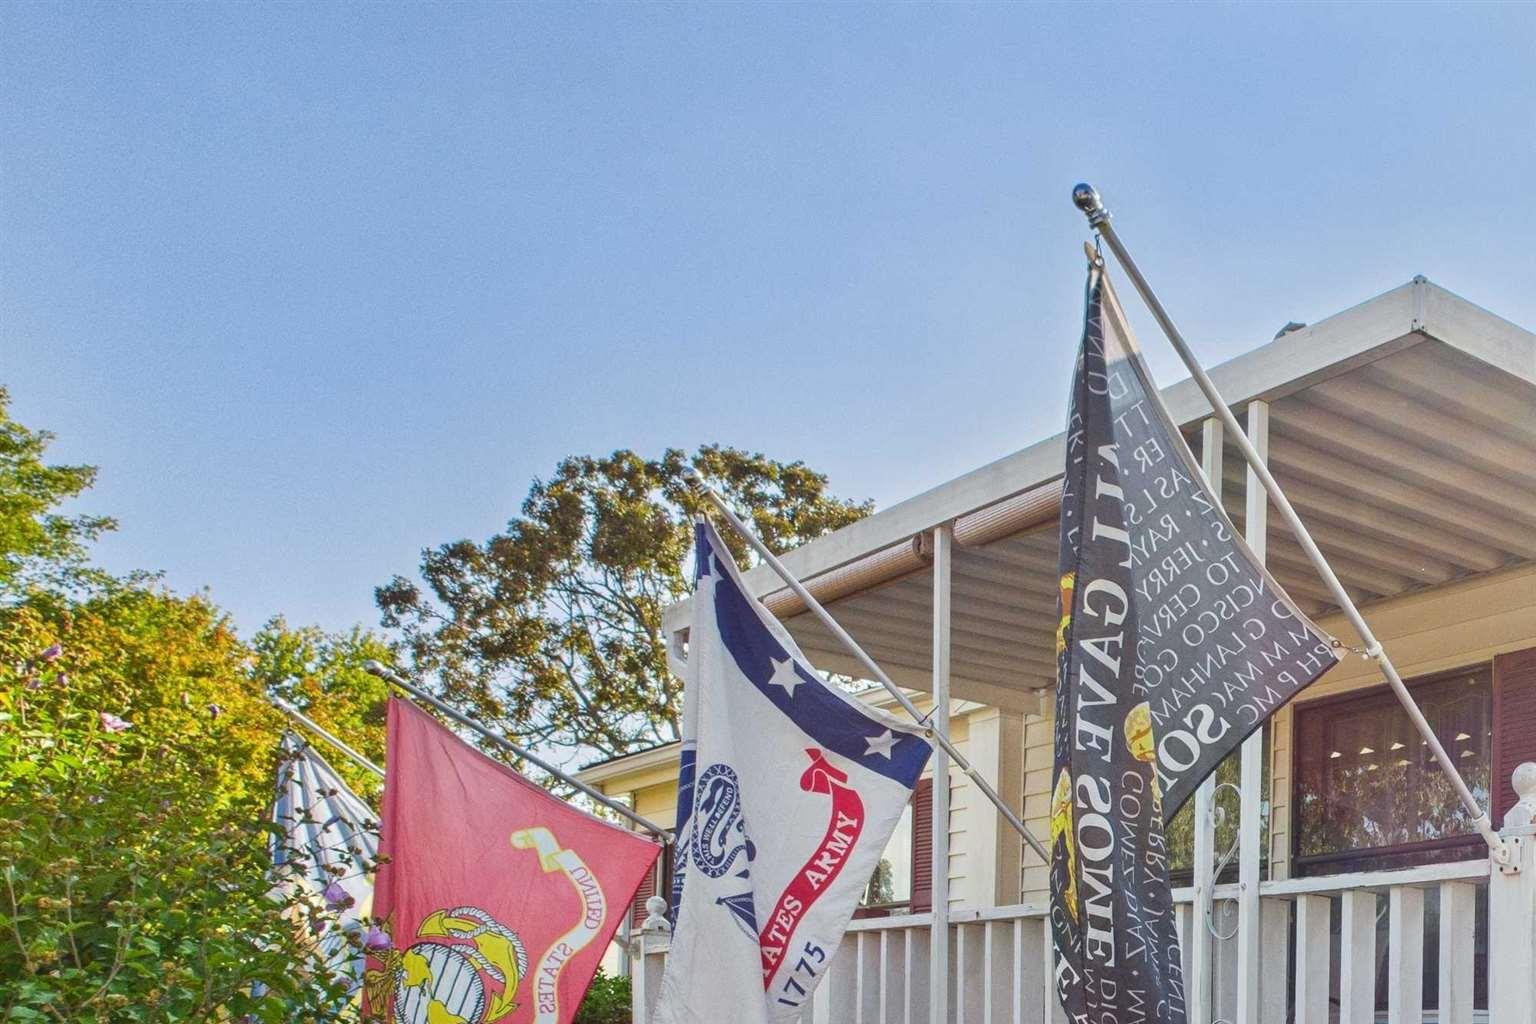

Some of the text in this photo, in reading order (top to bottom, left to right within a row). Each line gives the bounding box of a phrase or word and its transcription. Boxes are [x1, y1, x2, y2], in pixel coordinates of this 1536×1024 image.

[715, 787, 734, 819] DEFEND
[804, 810, 858, 891] ARMY
[777, 941, 826, 1008] 1775
